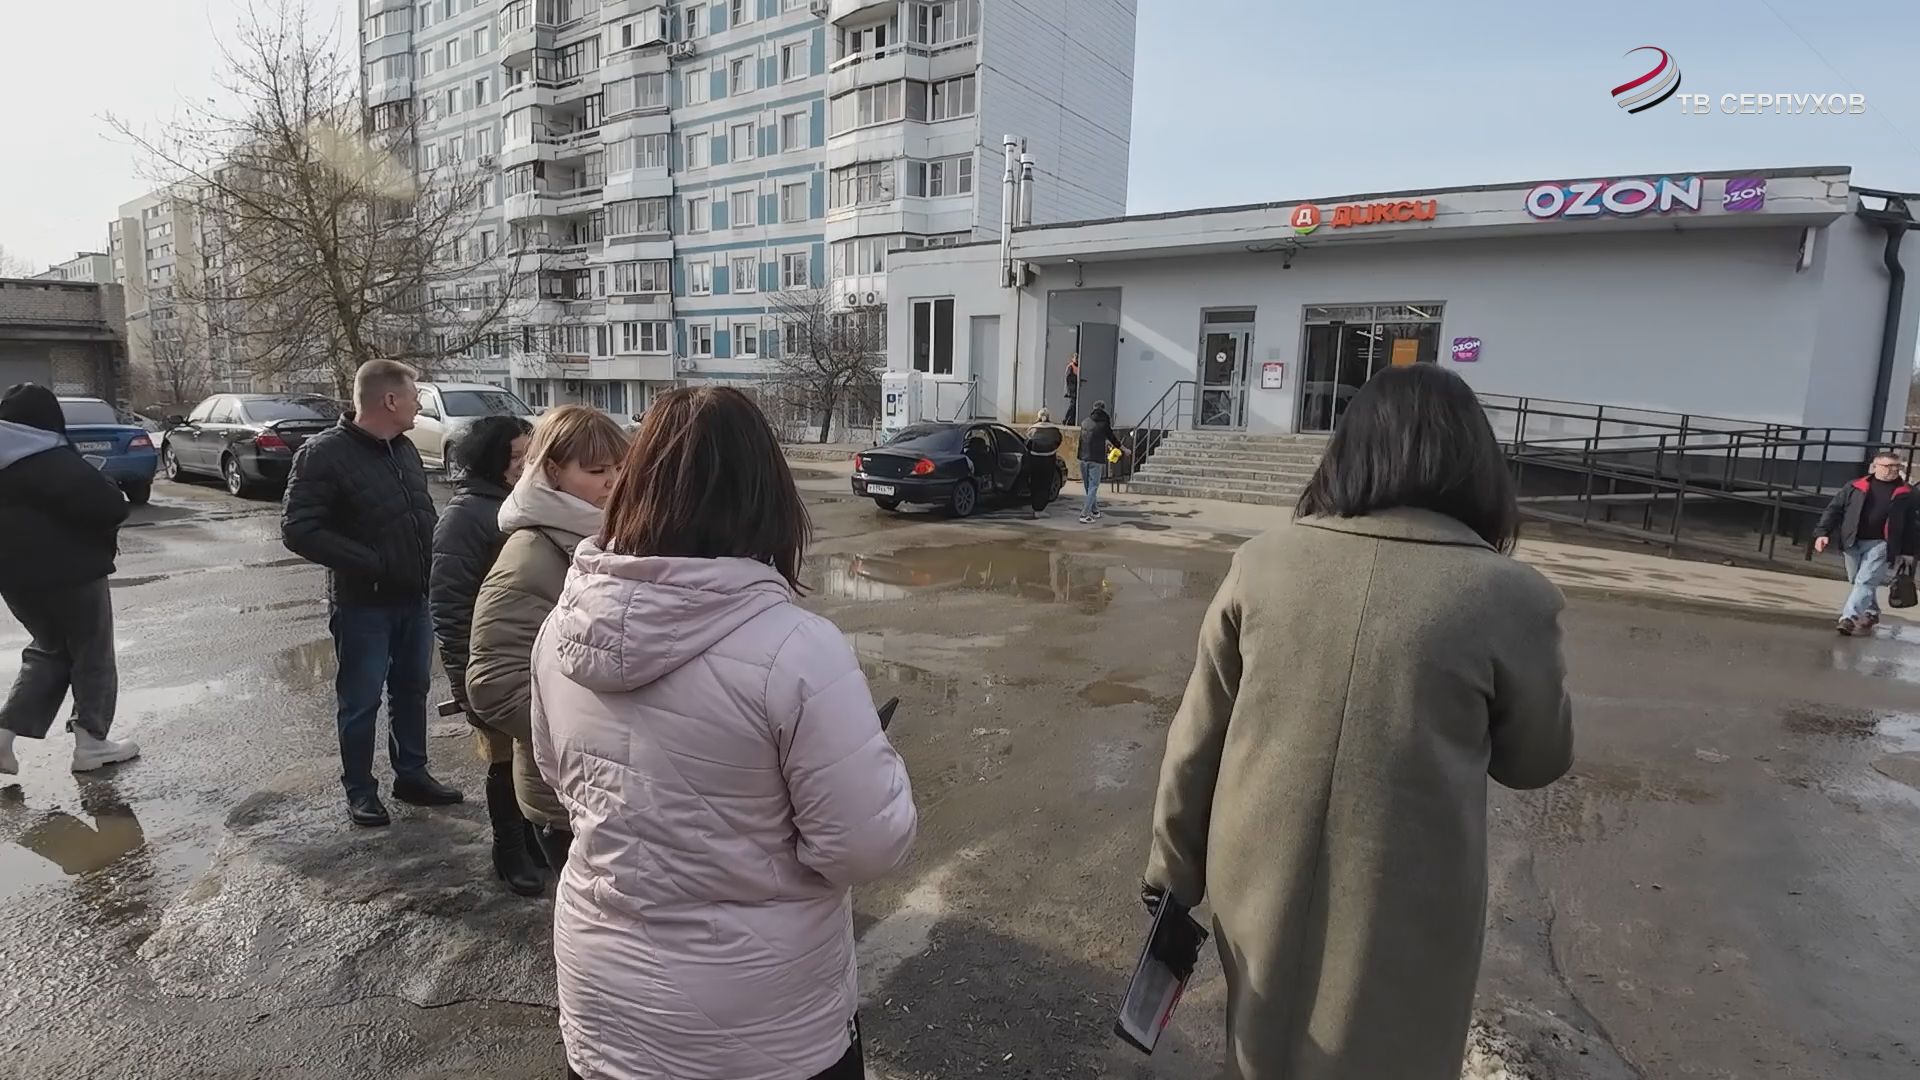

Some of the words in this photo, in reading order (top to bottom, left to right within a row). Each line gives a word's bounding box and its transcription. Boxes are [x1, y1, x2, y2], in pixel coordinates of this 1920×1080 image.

[1526, 177, 1702, 219] OZON
[1722, 185, 1768, 205] OZON
[1452, 340, 1481, 353] OZON
